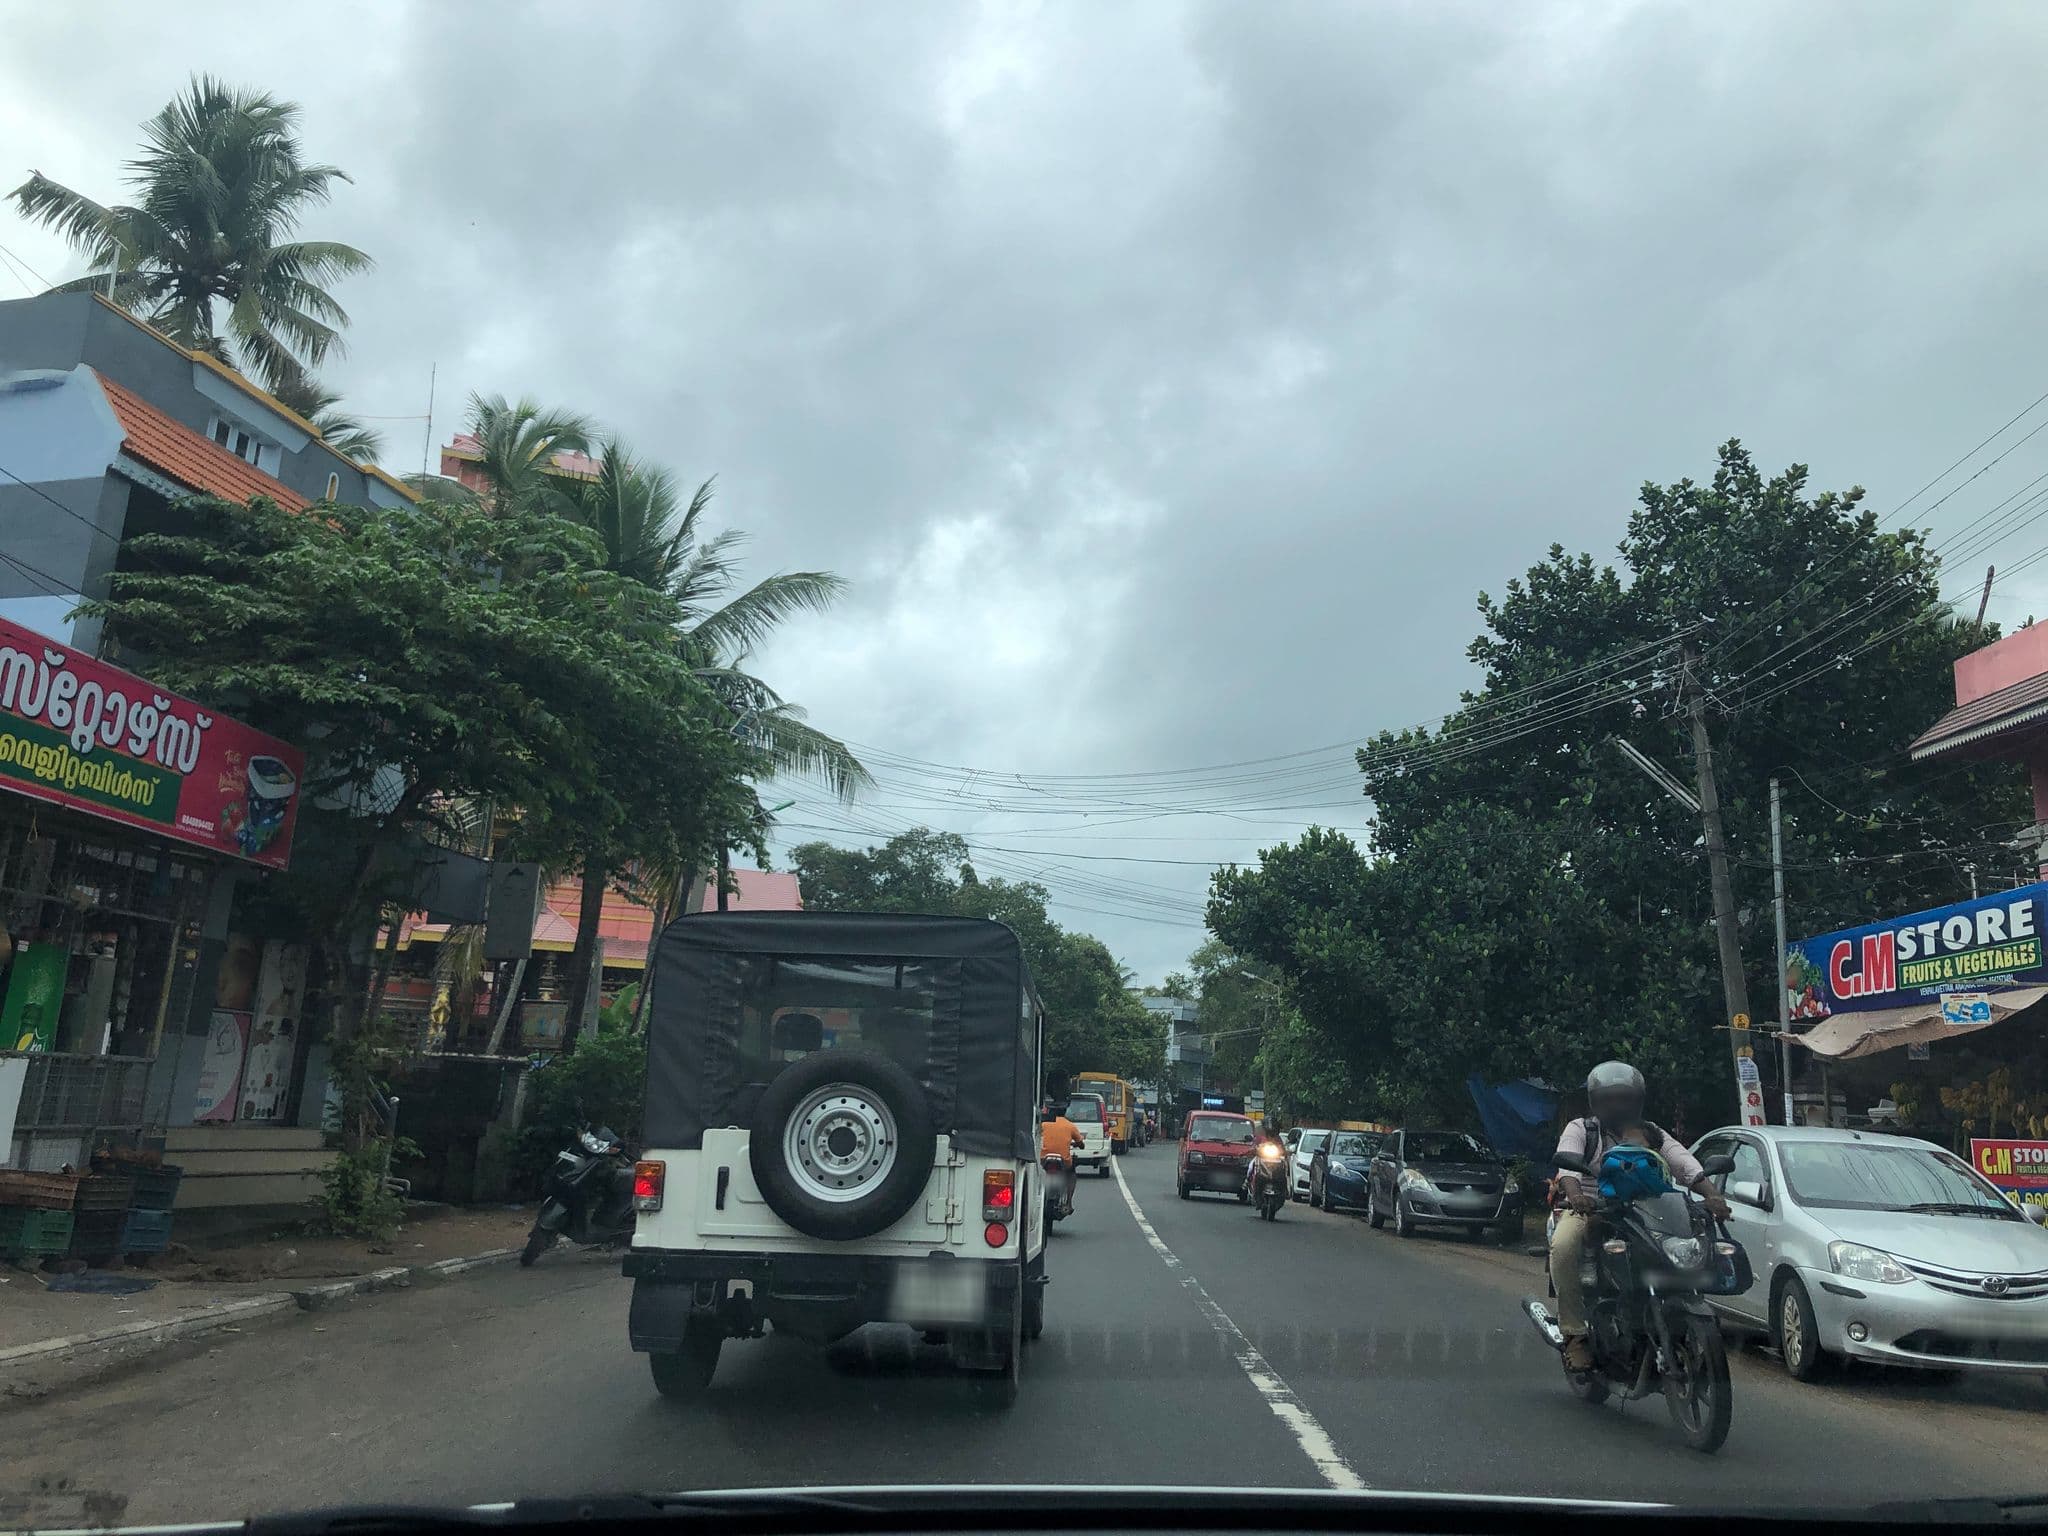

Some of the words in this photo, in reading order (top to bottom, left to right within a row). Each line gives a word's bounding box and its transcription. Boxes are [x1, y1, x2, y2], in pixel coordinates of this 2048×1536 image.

[1829, 930, 1897, 1000] C.M
[1896, 898, 2036, 960] STORE
[1902, 959, 1942, 985] FRUITS
[1943, 957, 1954, 977] &
[1956, 942, 2037, 976] VEGETABLES
[1981, 1147, 2012, 1176] C.M
